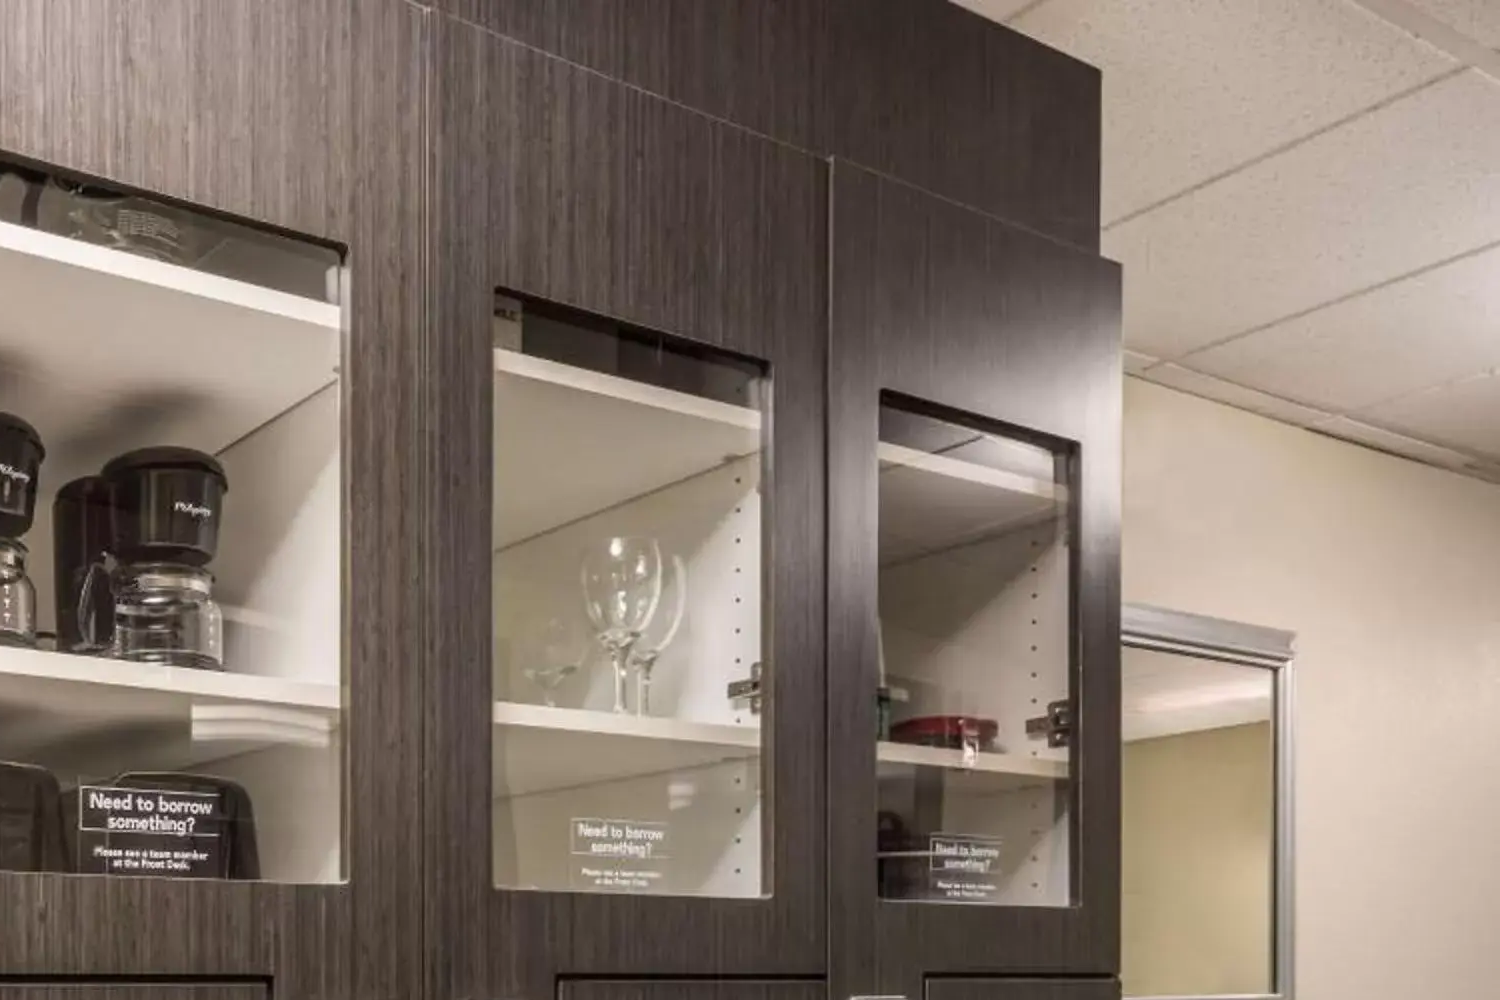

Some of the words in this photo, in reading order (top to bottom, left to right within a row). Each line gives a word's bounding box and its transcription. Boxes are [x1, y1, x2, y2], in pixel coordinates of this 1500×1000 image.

[88, 791, 133, 811] Need
[136, 795, 154, 812] to
[158, 795, 213, 815] borrow
[107, 813, 196, 837] something?
